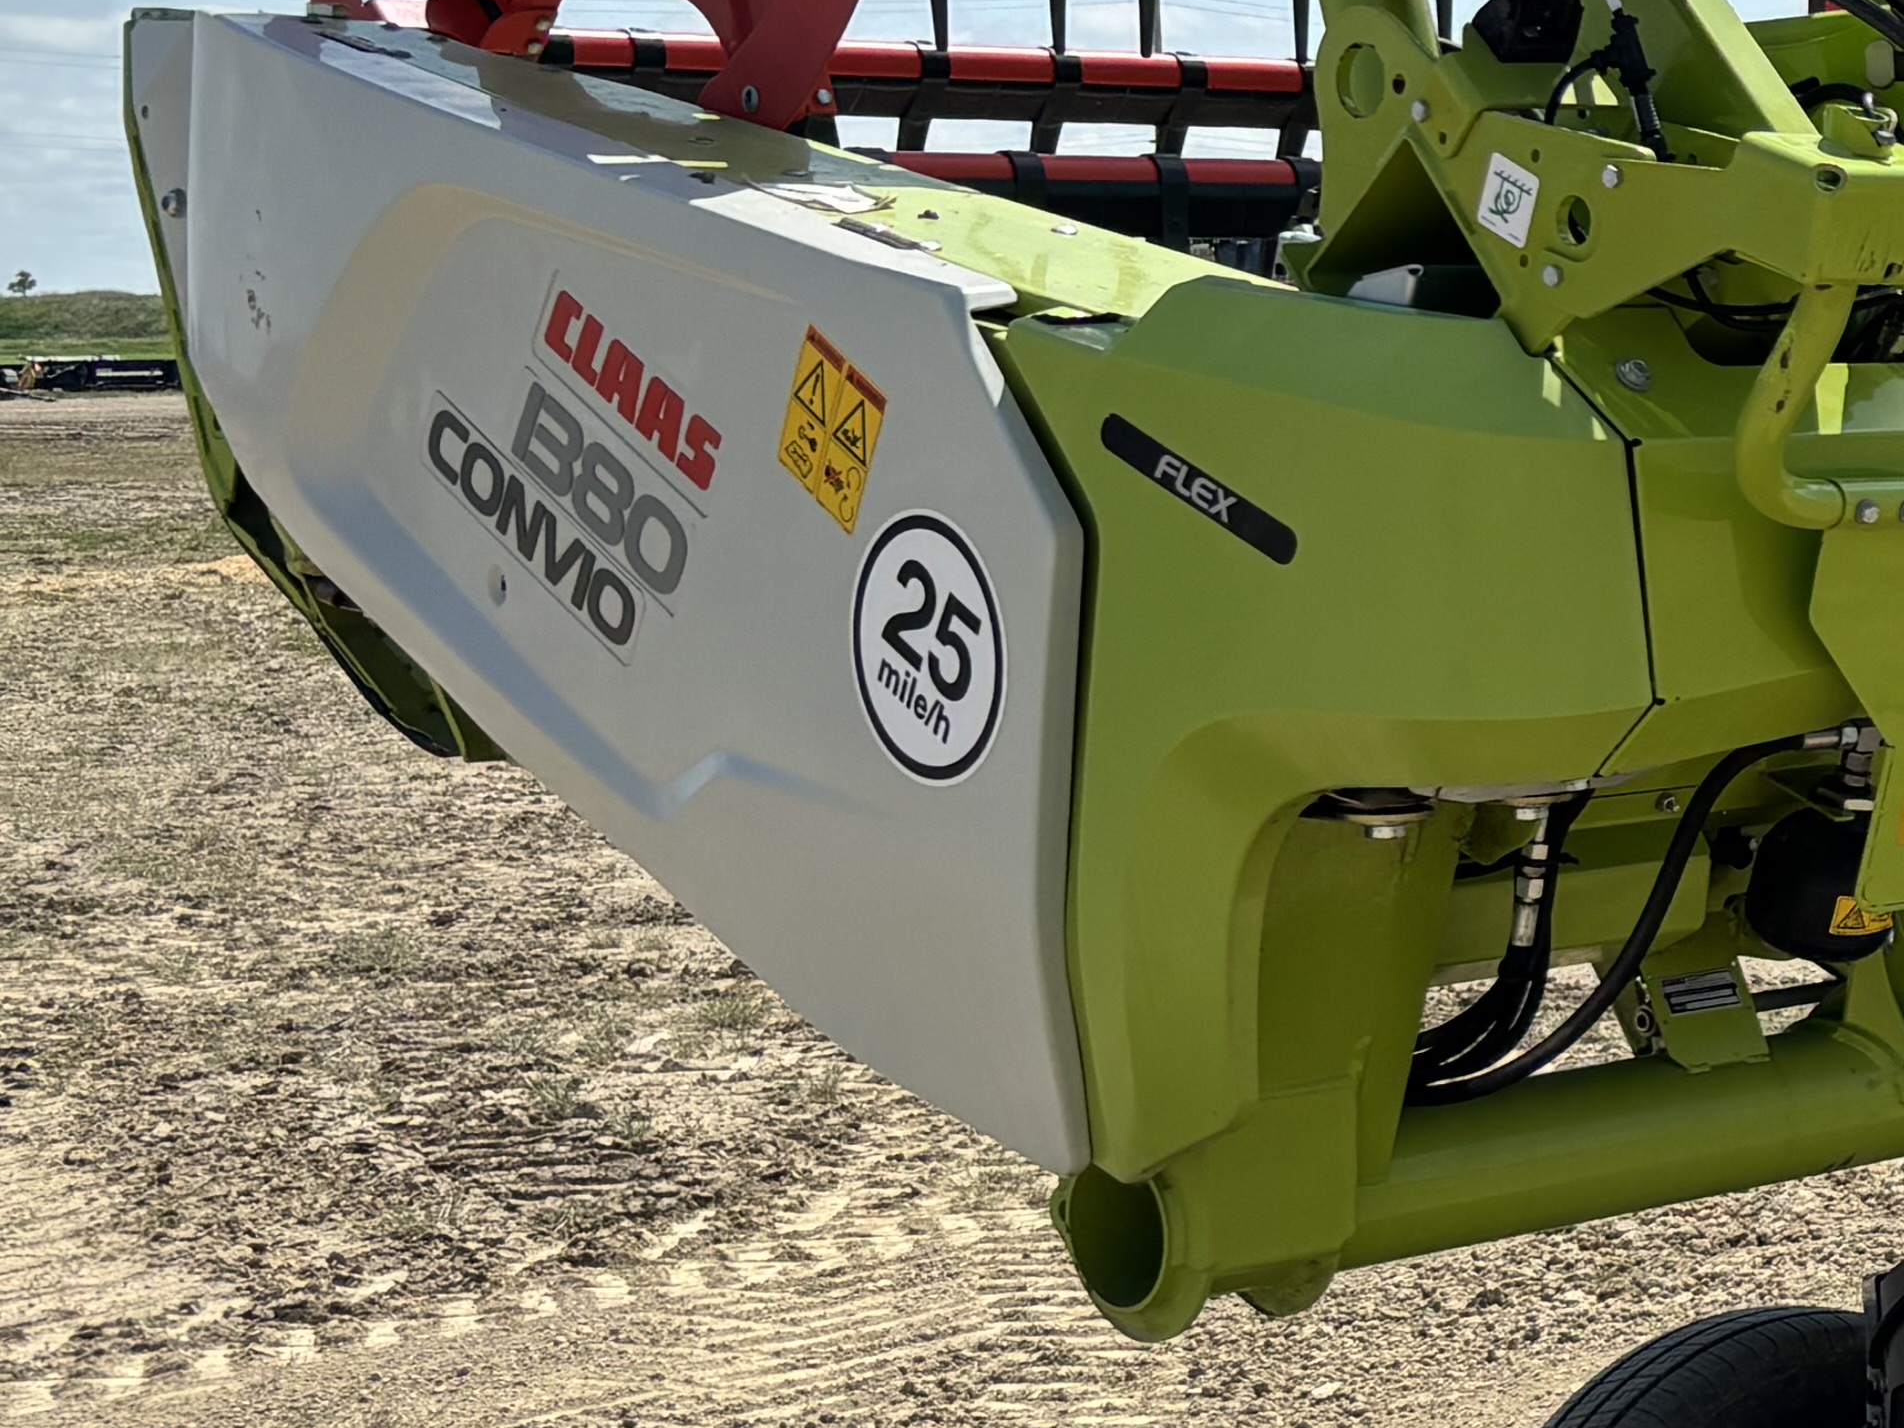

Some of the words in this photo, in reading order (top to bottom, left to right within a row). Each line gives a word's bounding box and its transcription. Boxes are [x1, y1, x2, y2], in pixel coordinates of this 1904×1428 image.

[544, 289, 722, 491] CLAAS
[428, 410, 635, 646] CONVIO
[1153, 454, 1238, 523] FLEX
[877, 658, 951, 745] mile/h
[881, 559, 982, 702] 25
